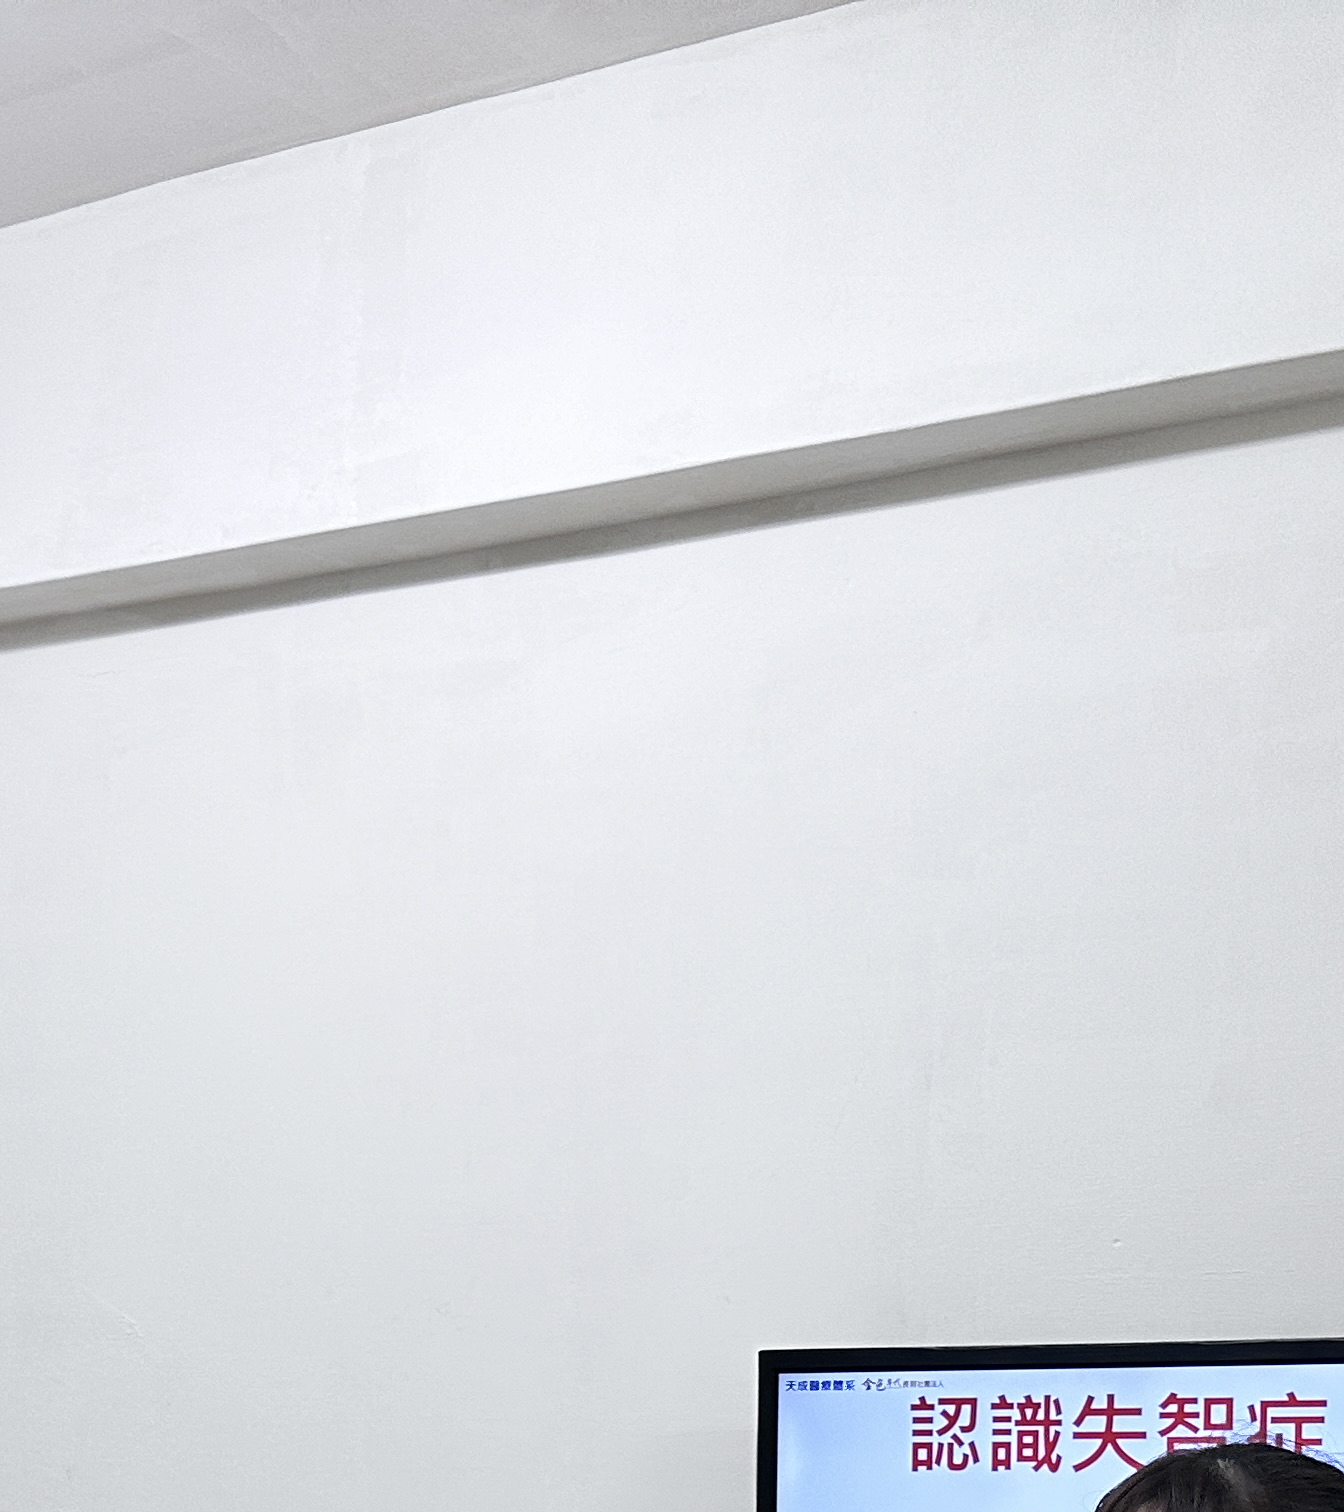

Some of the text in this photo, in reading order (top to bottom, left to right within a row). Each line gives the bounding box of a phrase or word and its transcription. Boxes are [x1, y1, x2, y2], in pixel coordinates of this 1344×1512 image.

[910, 1391, 1328, 1473] 認識失智症
